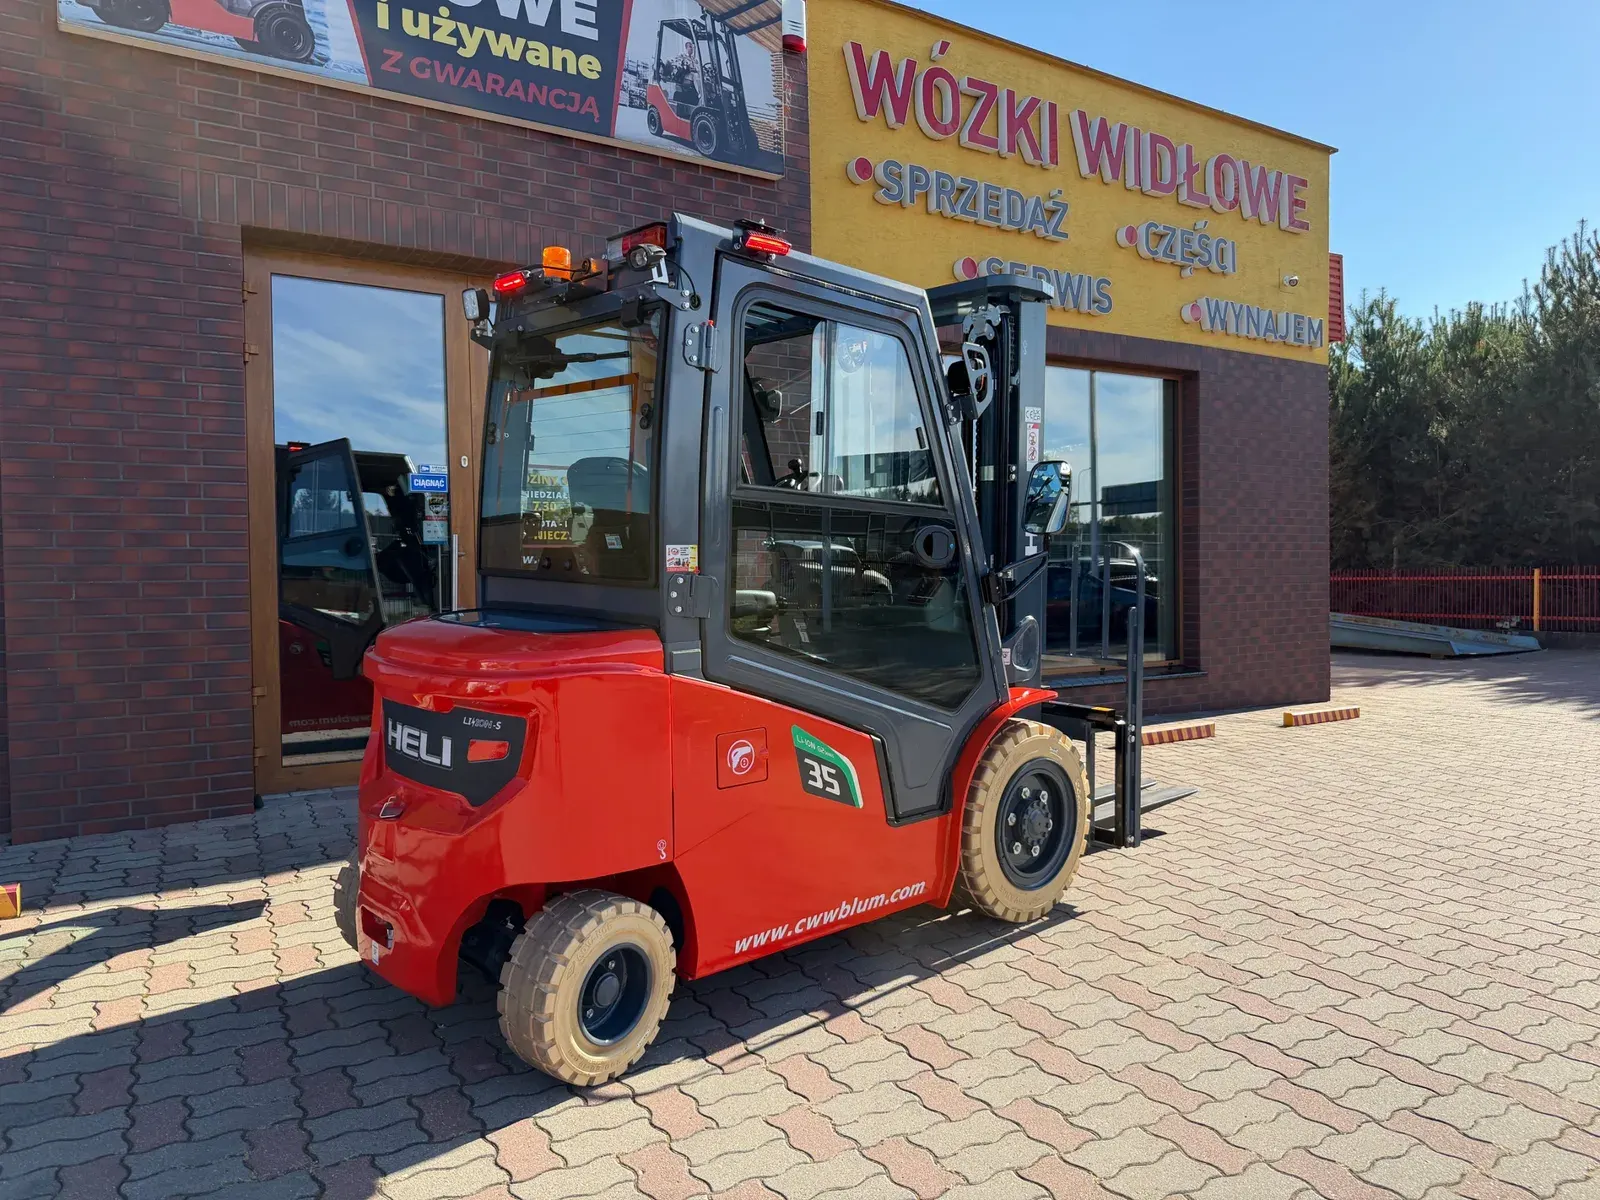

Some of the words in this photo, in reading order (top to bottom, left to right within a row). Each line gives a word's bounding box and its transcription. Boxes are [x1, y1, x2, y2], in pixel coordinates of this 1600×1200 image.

[376, 0, 390, 30] i
[401, 6, 602, 80] używane
[450, 0, 599, 41] WE
[380, 48, 404, 74] Z
[409, 56, 601, 123] GWARANCJĄ
[843, 40, 1059, 169] WÓZKI
[1069, 108, 1311, 233] WIDŁOWE
[874, 159, 1069, 241] SPRZEDAŻ
[1136, 219, 1237, 277] CZĘŚCI
[1200, 296, 1324, 348] WYNAJEM
[413, 478, 445, 489] CIĄGNĄĆ
[527, 474, 558, 486] ZINY
[532, 501, 557, 512] 7.30
[387, 718, 453, 769] HELI
[804, 758, 841, 796] 35
[734, 879, 926, 955] www.cwwblum.com
